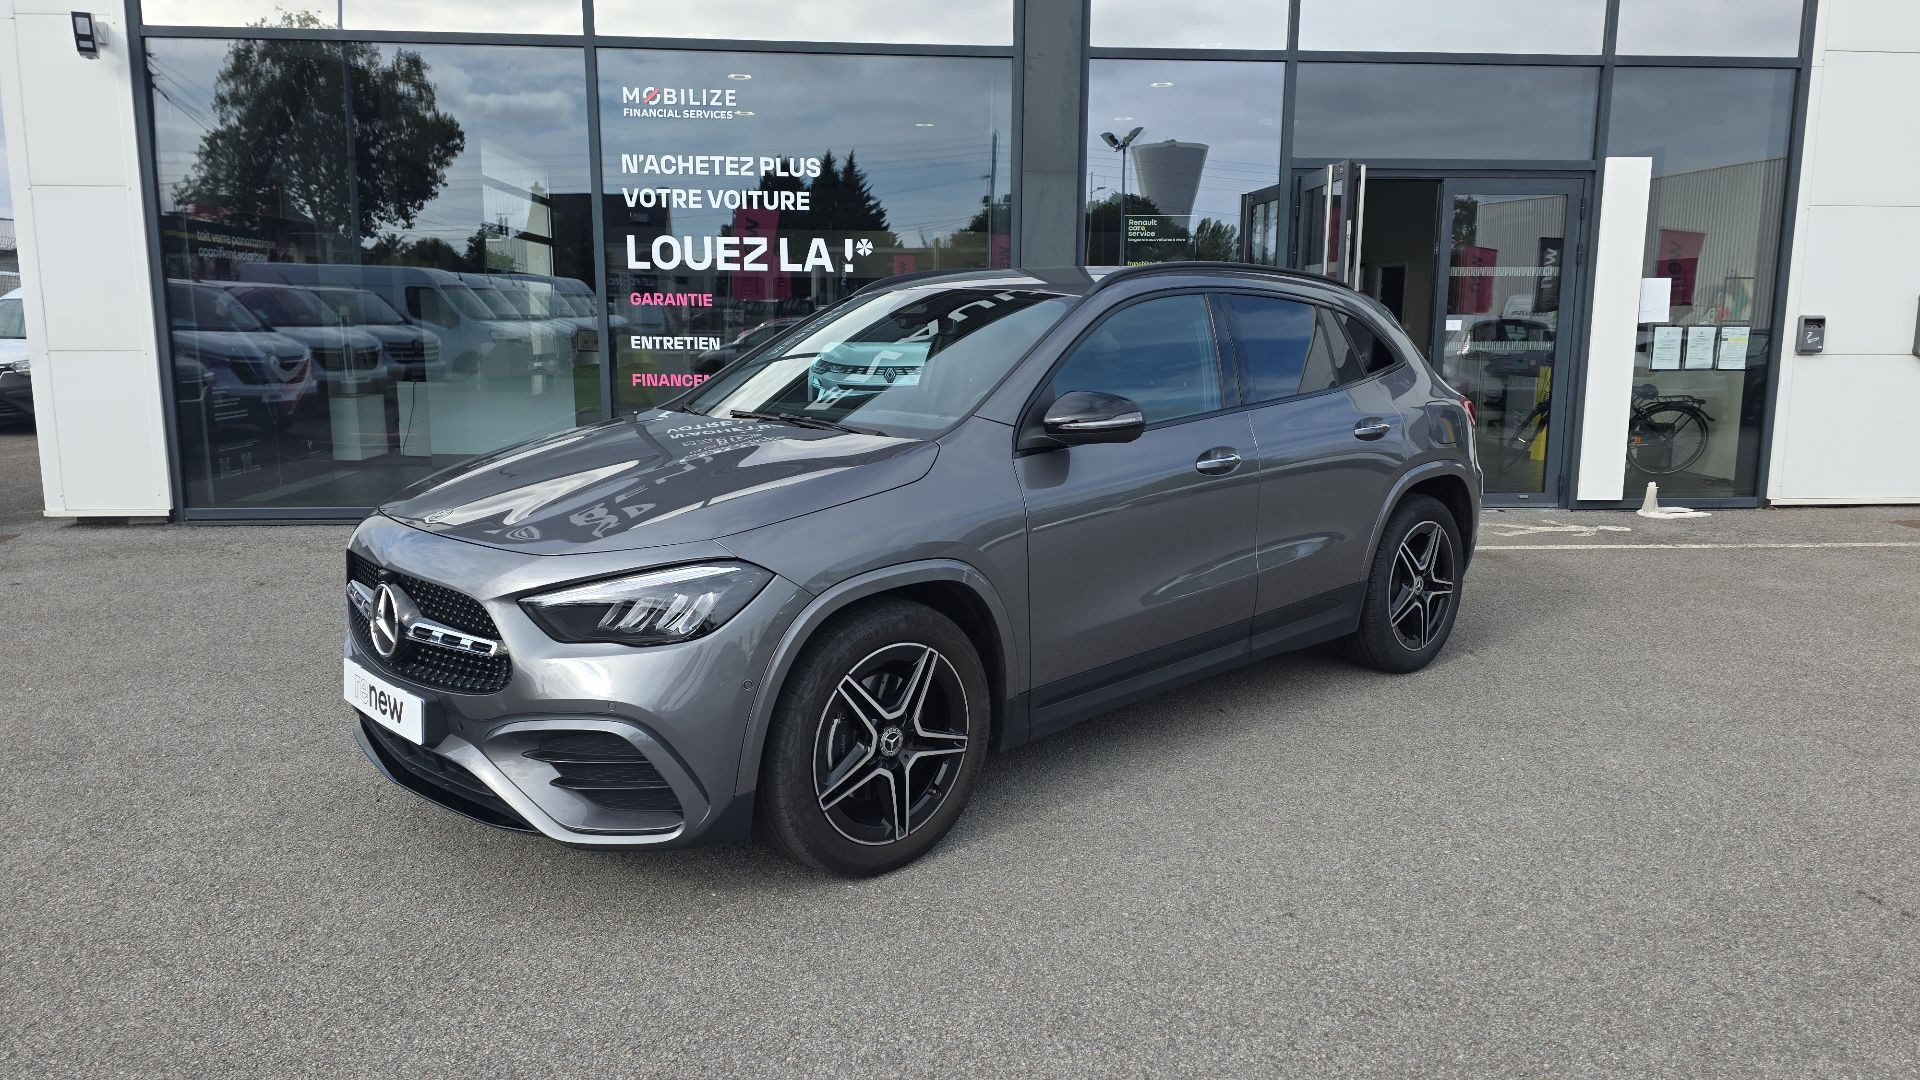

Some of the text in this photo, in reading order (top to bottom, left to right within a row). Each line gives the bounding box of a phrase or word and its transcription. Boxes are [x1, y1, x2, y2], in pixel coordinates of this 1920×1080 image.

[622, 86, 737, 107] MOBILIZE
[623, 107, 733, 120] FINANCIAL SERVICES
[621, 153, 821, 178] N'ACHETEZ PLUS
[621, 187, 810, 211] VOTRE VOITURE
[1128, 218, 1158, 226] Renault
[626, 234, 768, 271] LOUEZ
[779, 237, 835, 273] LA
[629, 291, 713, 307] GARANTIE
[630, 335, 720, 351] ENTRETIEN
